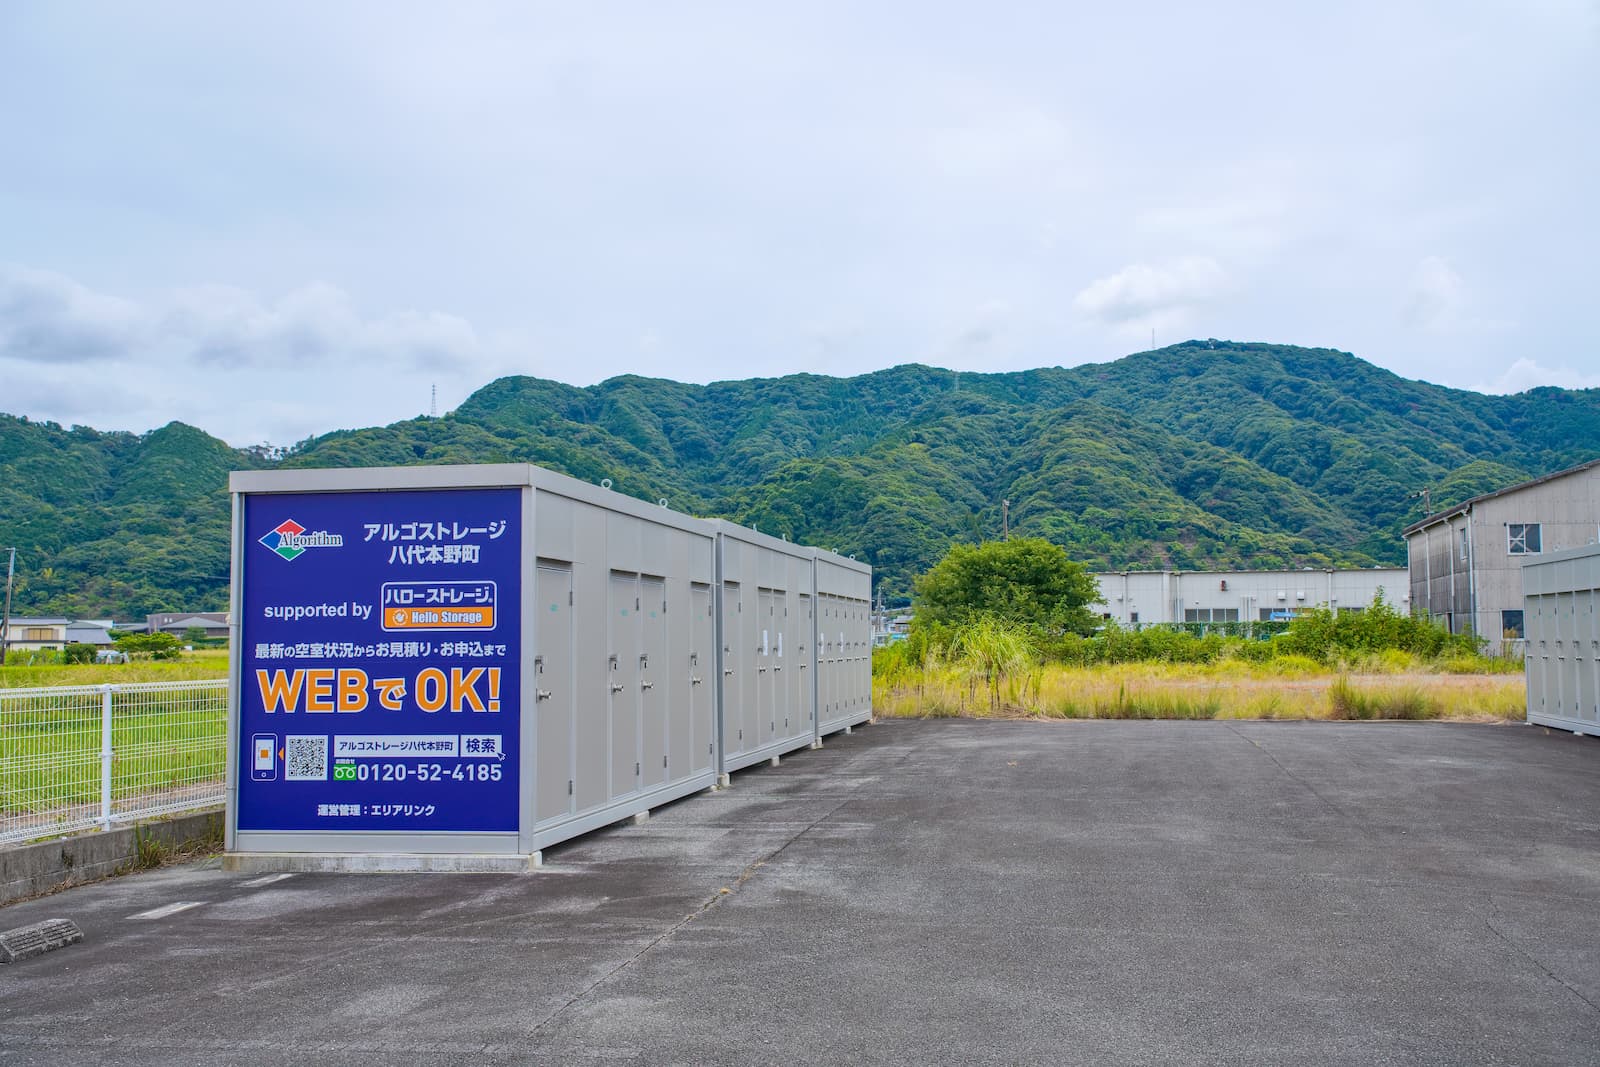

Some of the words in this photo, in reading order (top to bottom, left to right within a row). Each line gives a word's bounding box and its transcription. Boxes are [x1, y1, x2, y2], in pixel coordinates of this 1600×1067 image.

[364, 520, 506, 541] アルゴストレージ
[280, 532, 342, 548] Algorithm
[389, 545, 480, 564] 八代本野町
[385, 587, 491, 603] ハローストレージ
[264, 602, 347, 620] supported
[353, 602, 372, 620] by
[411, 611, 438, 623] Hello
[441, 611, 482, 624] Storage
[340, 740, 454, 751] アルゴストレージ八代本野町
[466, 738, 496, 752] 検索
[358, 764, 501, 781] 0120-52-4185
